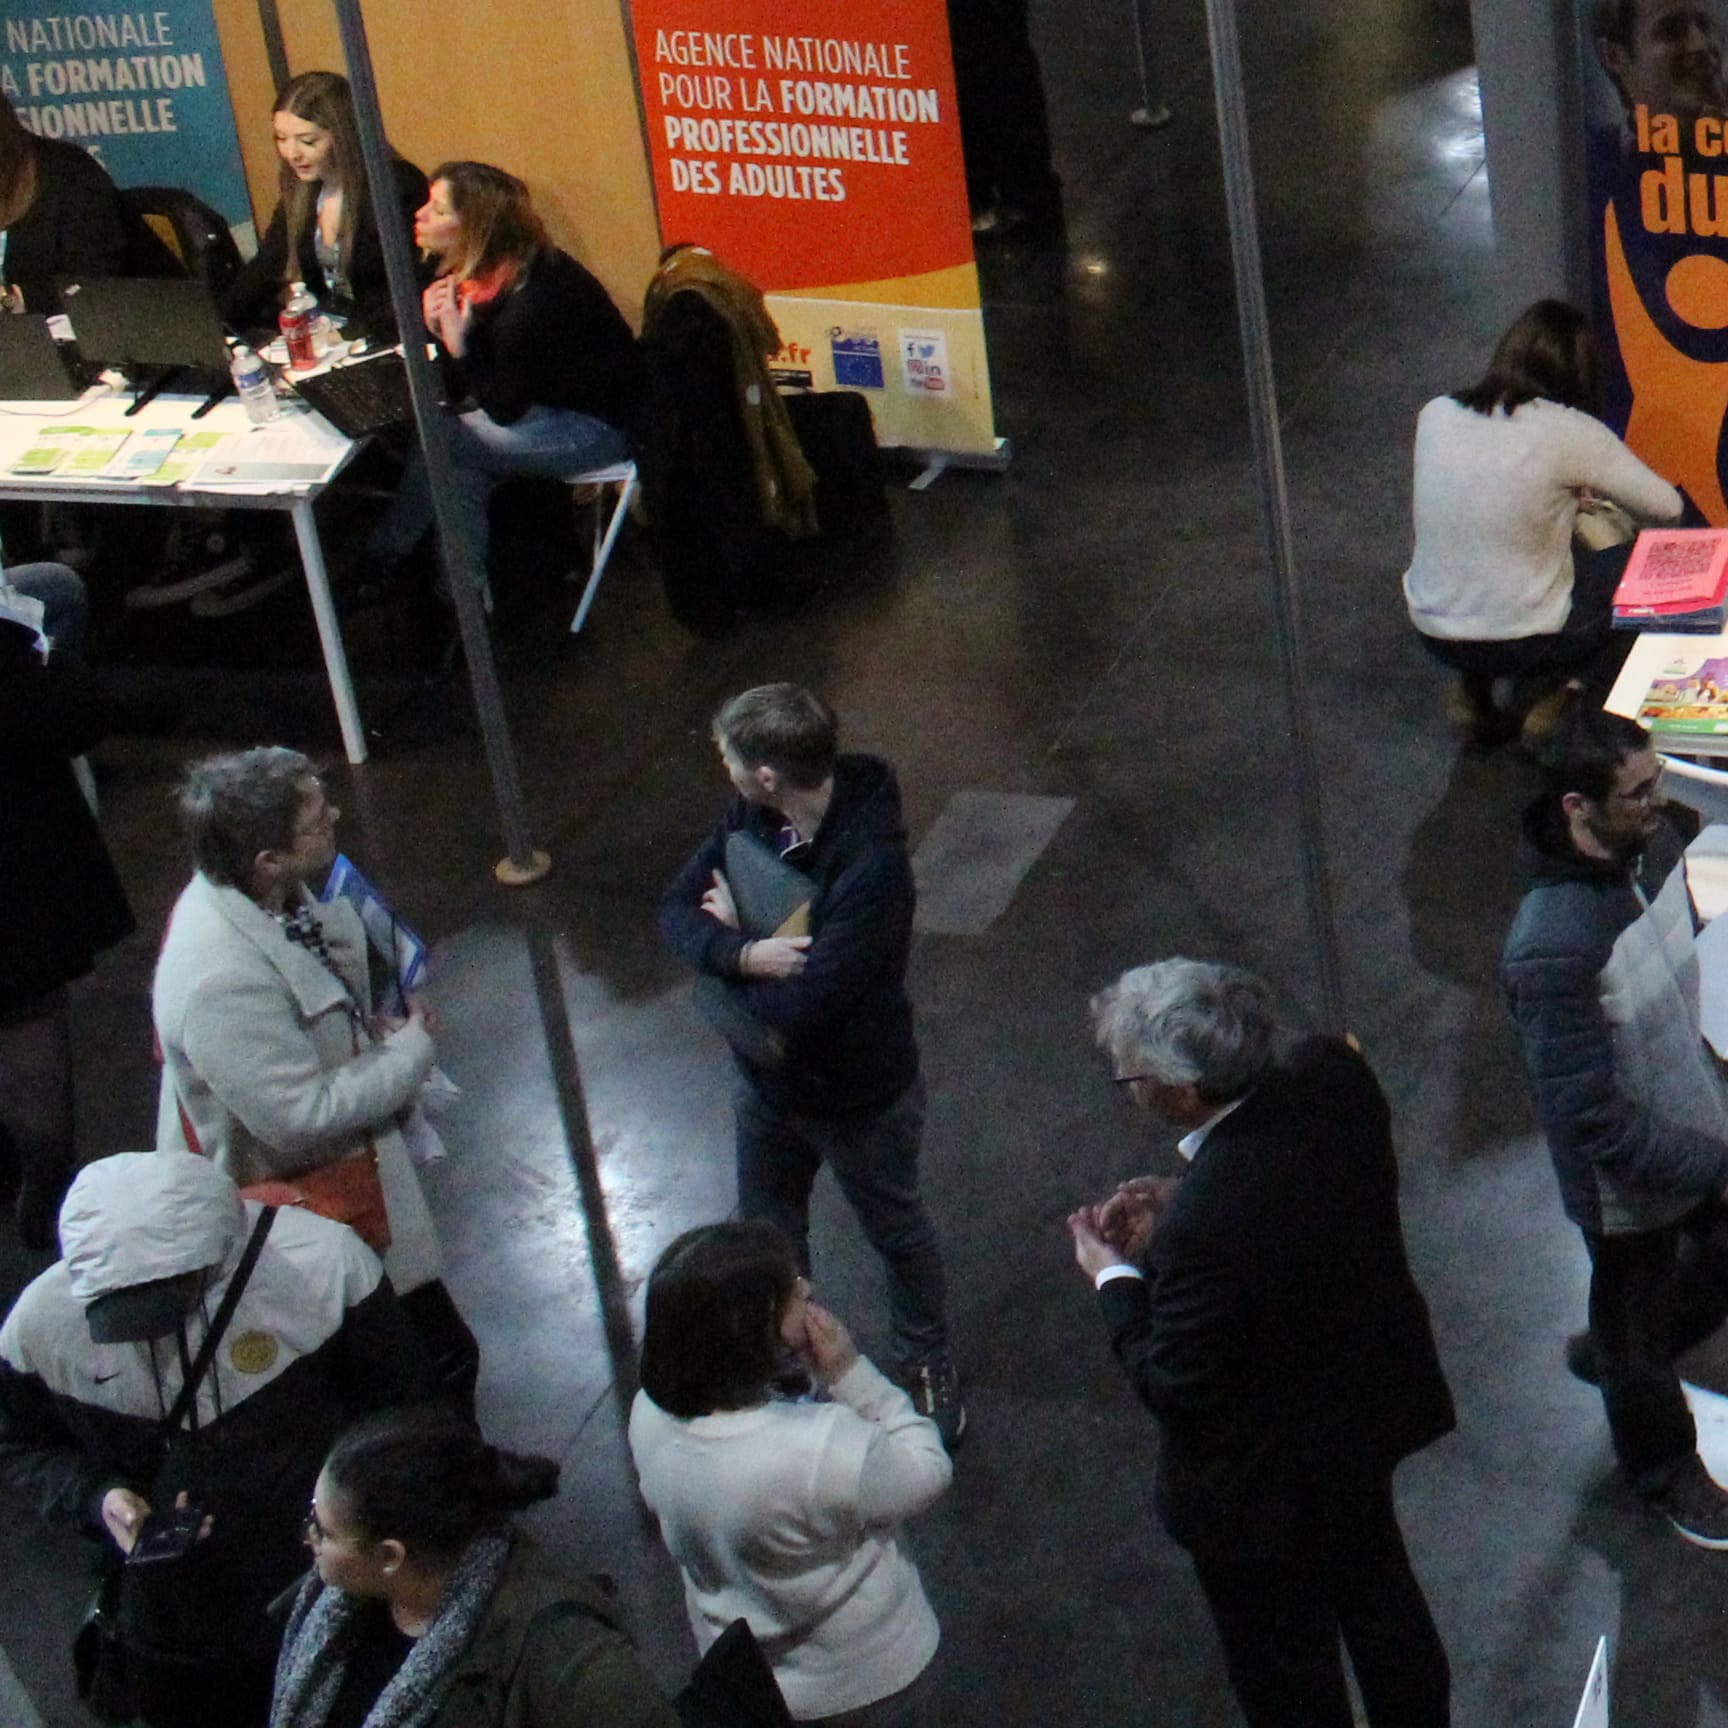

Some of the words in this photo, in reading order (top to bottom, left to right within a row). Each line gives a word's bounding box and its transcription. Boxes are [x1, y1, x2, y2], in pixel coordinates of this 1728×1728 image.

[7, 12, 174, 55] NATIONALE
[654, 28, 756, 72] AGENCE
[763, 33, 913, 80] NATIONALE
[27, 53, 206, 96] FORMATION
[659, 73, 734, 113] POUR
[740, 77, 777, 114] LA
[779, 78, 940, 125] FORMATION
[664, 114, 910, 167] PROFESSIONNELLE
[1636, 104, 1681, 155] la
[670, 156, 723, 196] DES
[727, 160, 846, 203] ADULTES
